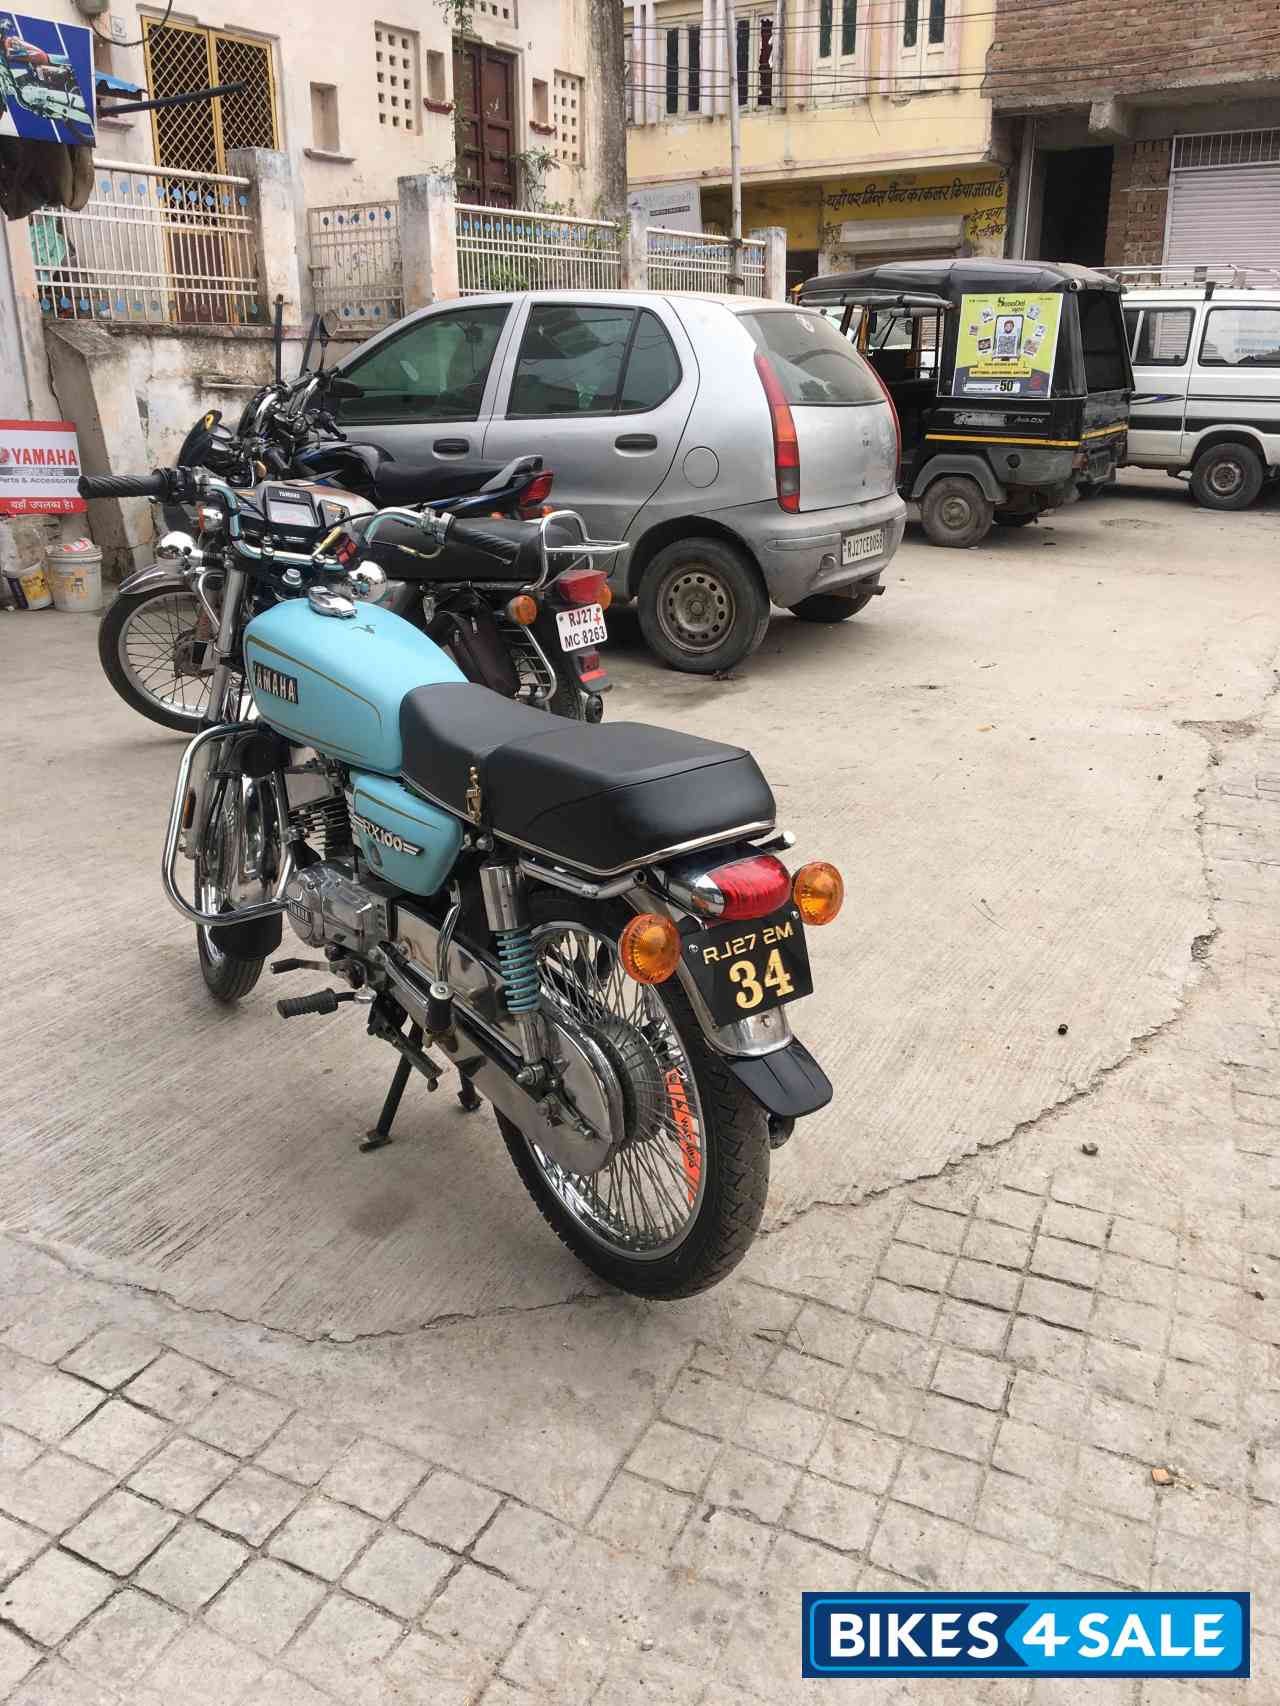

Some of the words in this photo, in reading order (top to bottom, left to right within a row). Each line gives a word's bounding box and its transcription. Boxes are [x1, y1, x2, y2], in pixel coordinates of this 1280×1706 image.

[1000, 379, 1014, 392] 50
[11, 447, 78, 465] YAMAHA
[569, 608, 592, 627] RJ27
[564, 633, 581, 648] MC
[582, 626, 606, 644] 8263
[702, 933, 757, 965] RJ27
[762, 921, 795, 945] 2M
[728, 948, 795, 1009] 34
